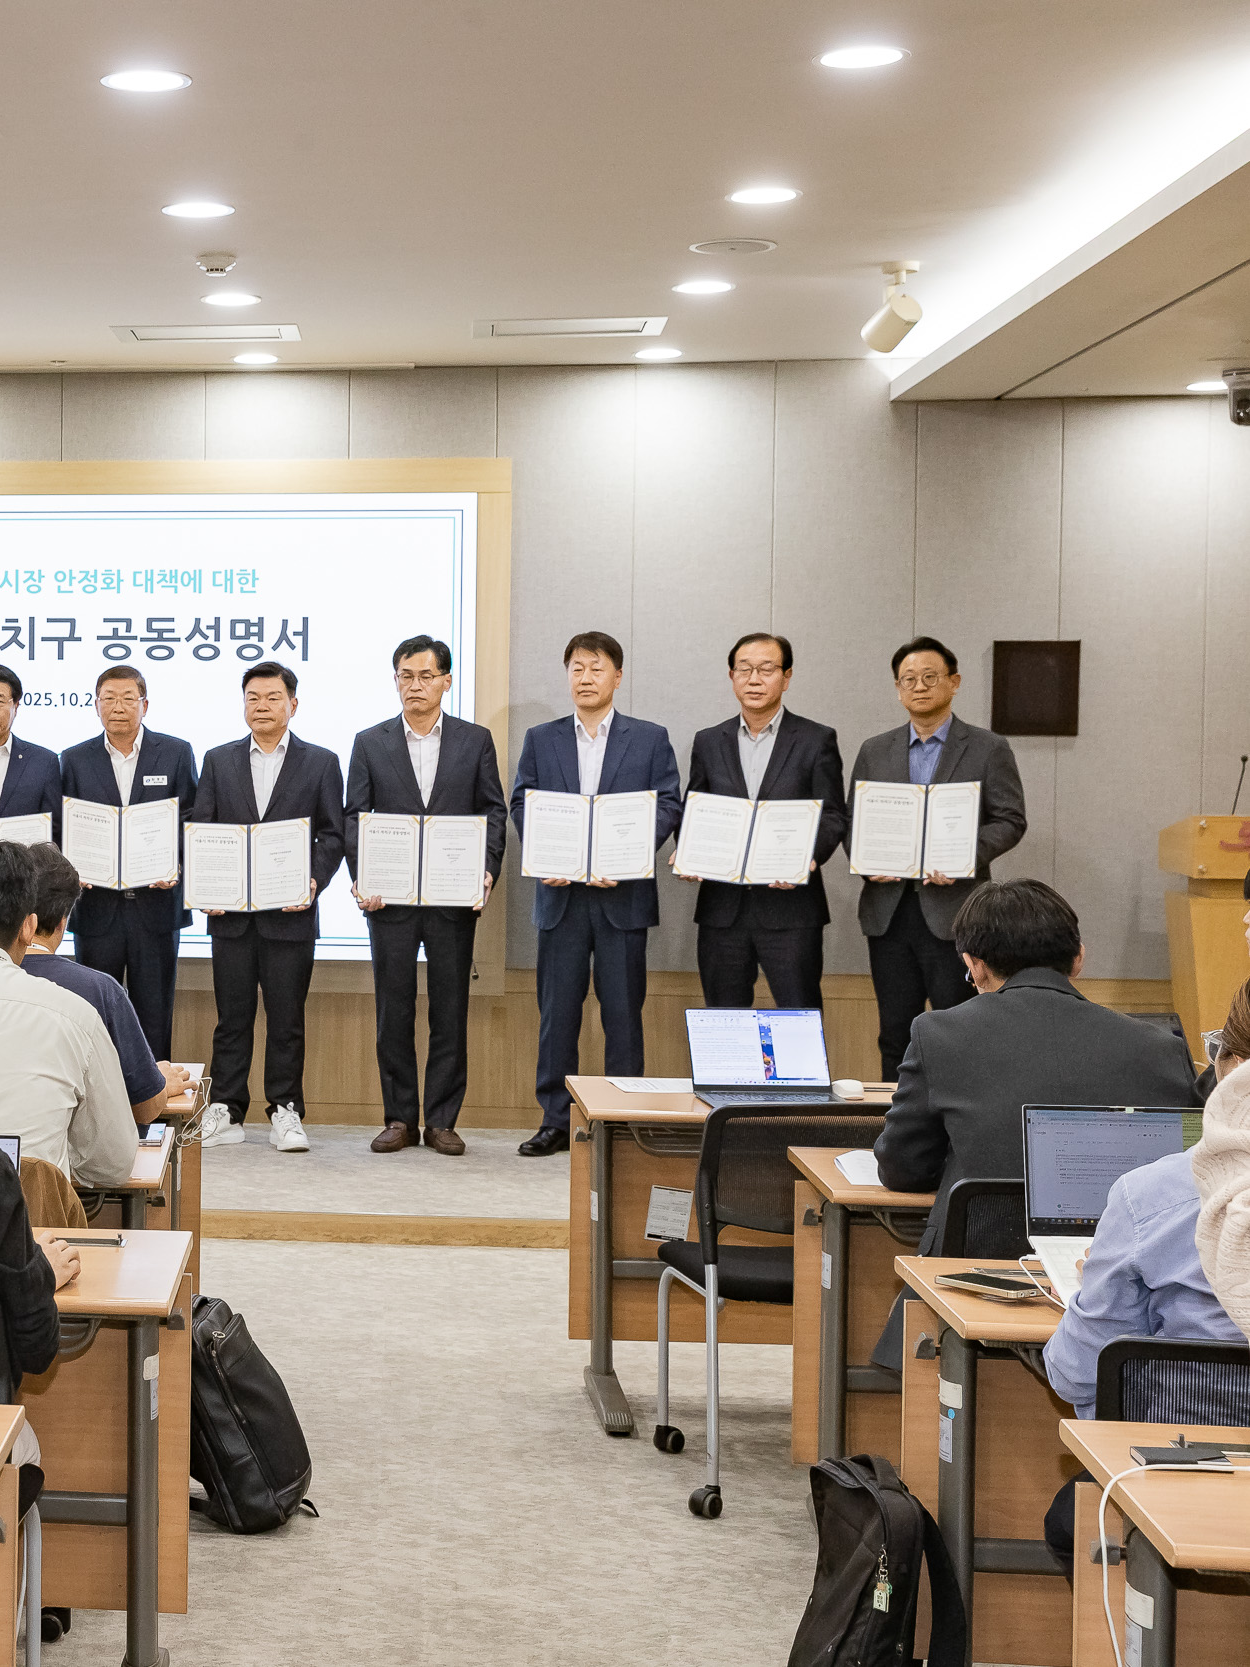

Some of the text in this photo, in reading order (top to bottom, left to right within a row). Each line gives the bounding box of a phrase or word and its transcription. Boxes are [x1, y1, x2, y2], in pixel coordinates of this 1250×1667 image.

[54, 569, 124, 594] 안정화
[132, 569, 202, 594] 대책에
[212, 569, 260, 594] 대한
[96, 616, 309, 662] 공동성명서
[19, 692, 93, 708] 025.10.2
